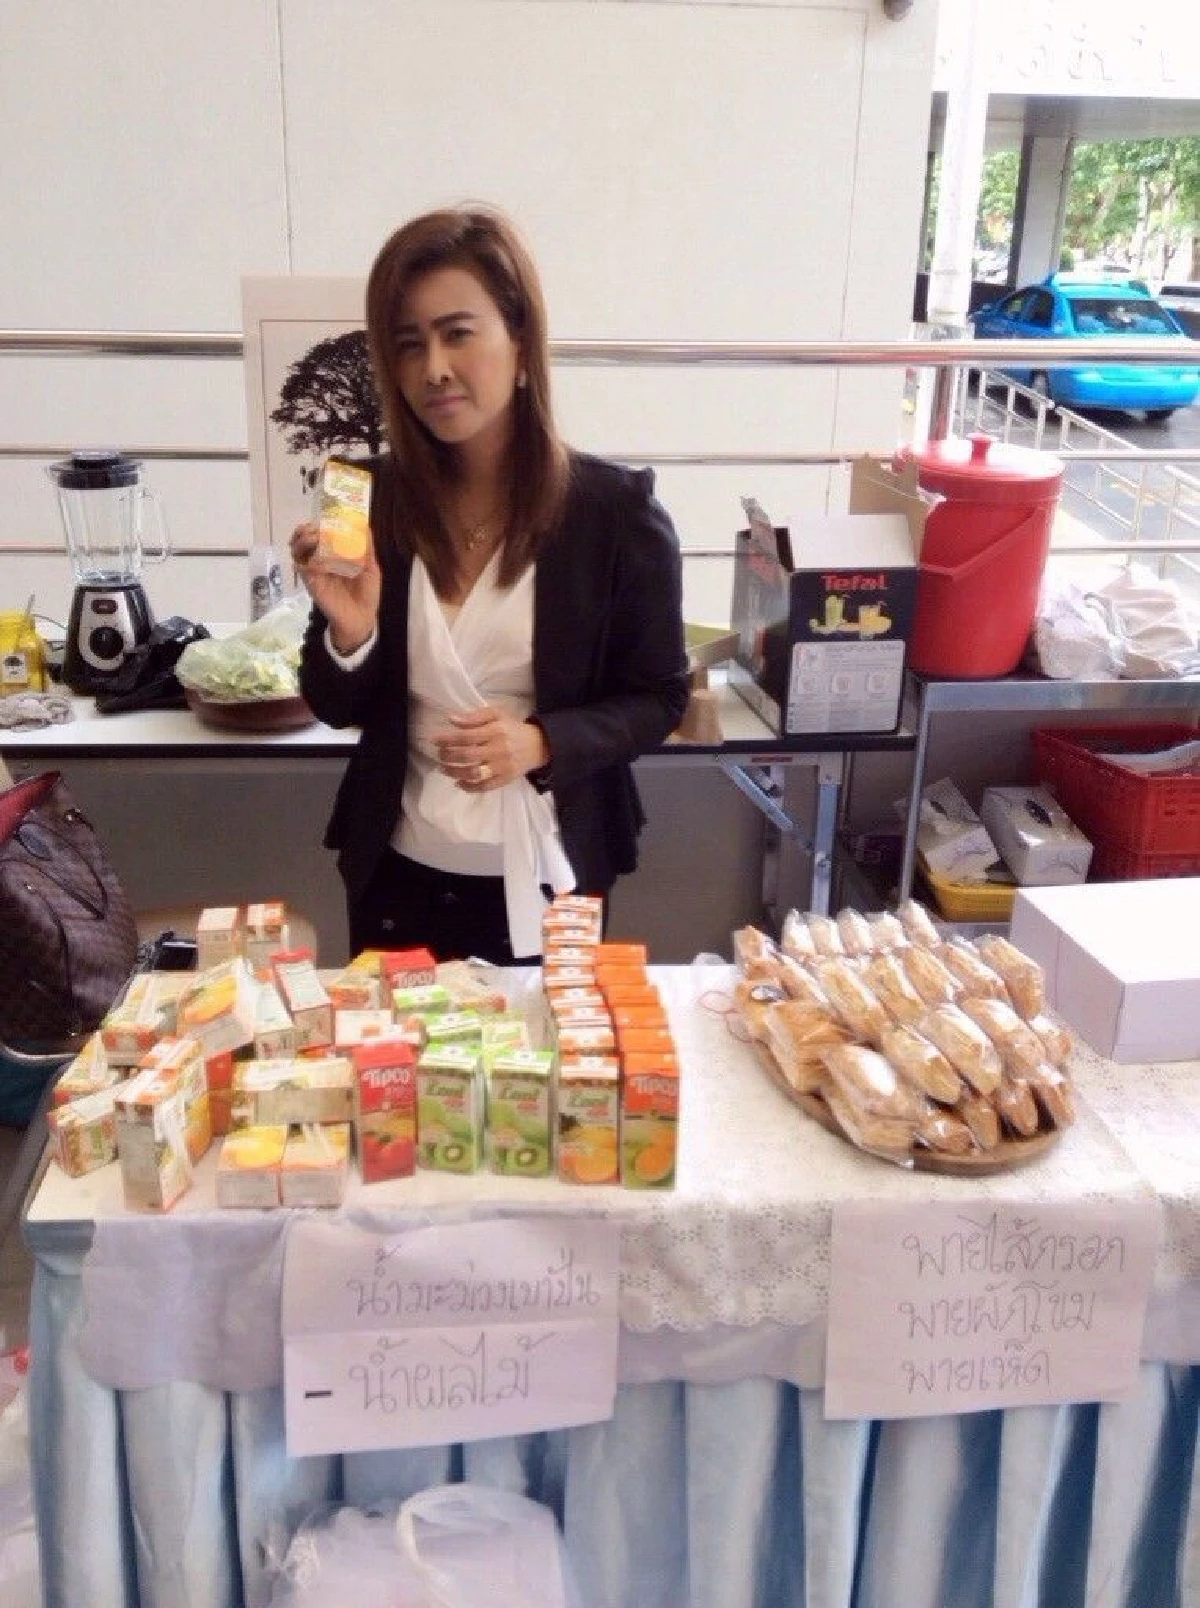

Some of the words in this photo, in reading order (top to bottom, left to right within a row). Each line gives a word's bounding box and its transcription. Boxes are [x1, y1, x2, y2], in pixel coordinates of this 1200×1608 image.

[822, 574, 888, 591] Tefal
[349, 1331, 560, 1413] น้ำผลไม้
